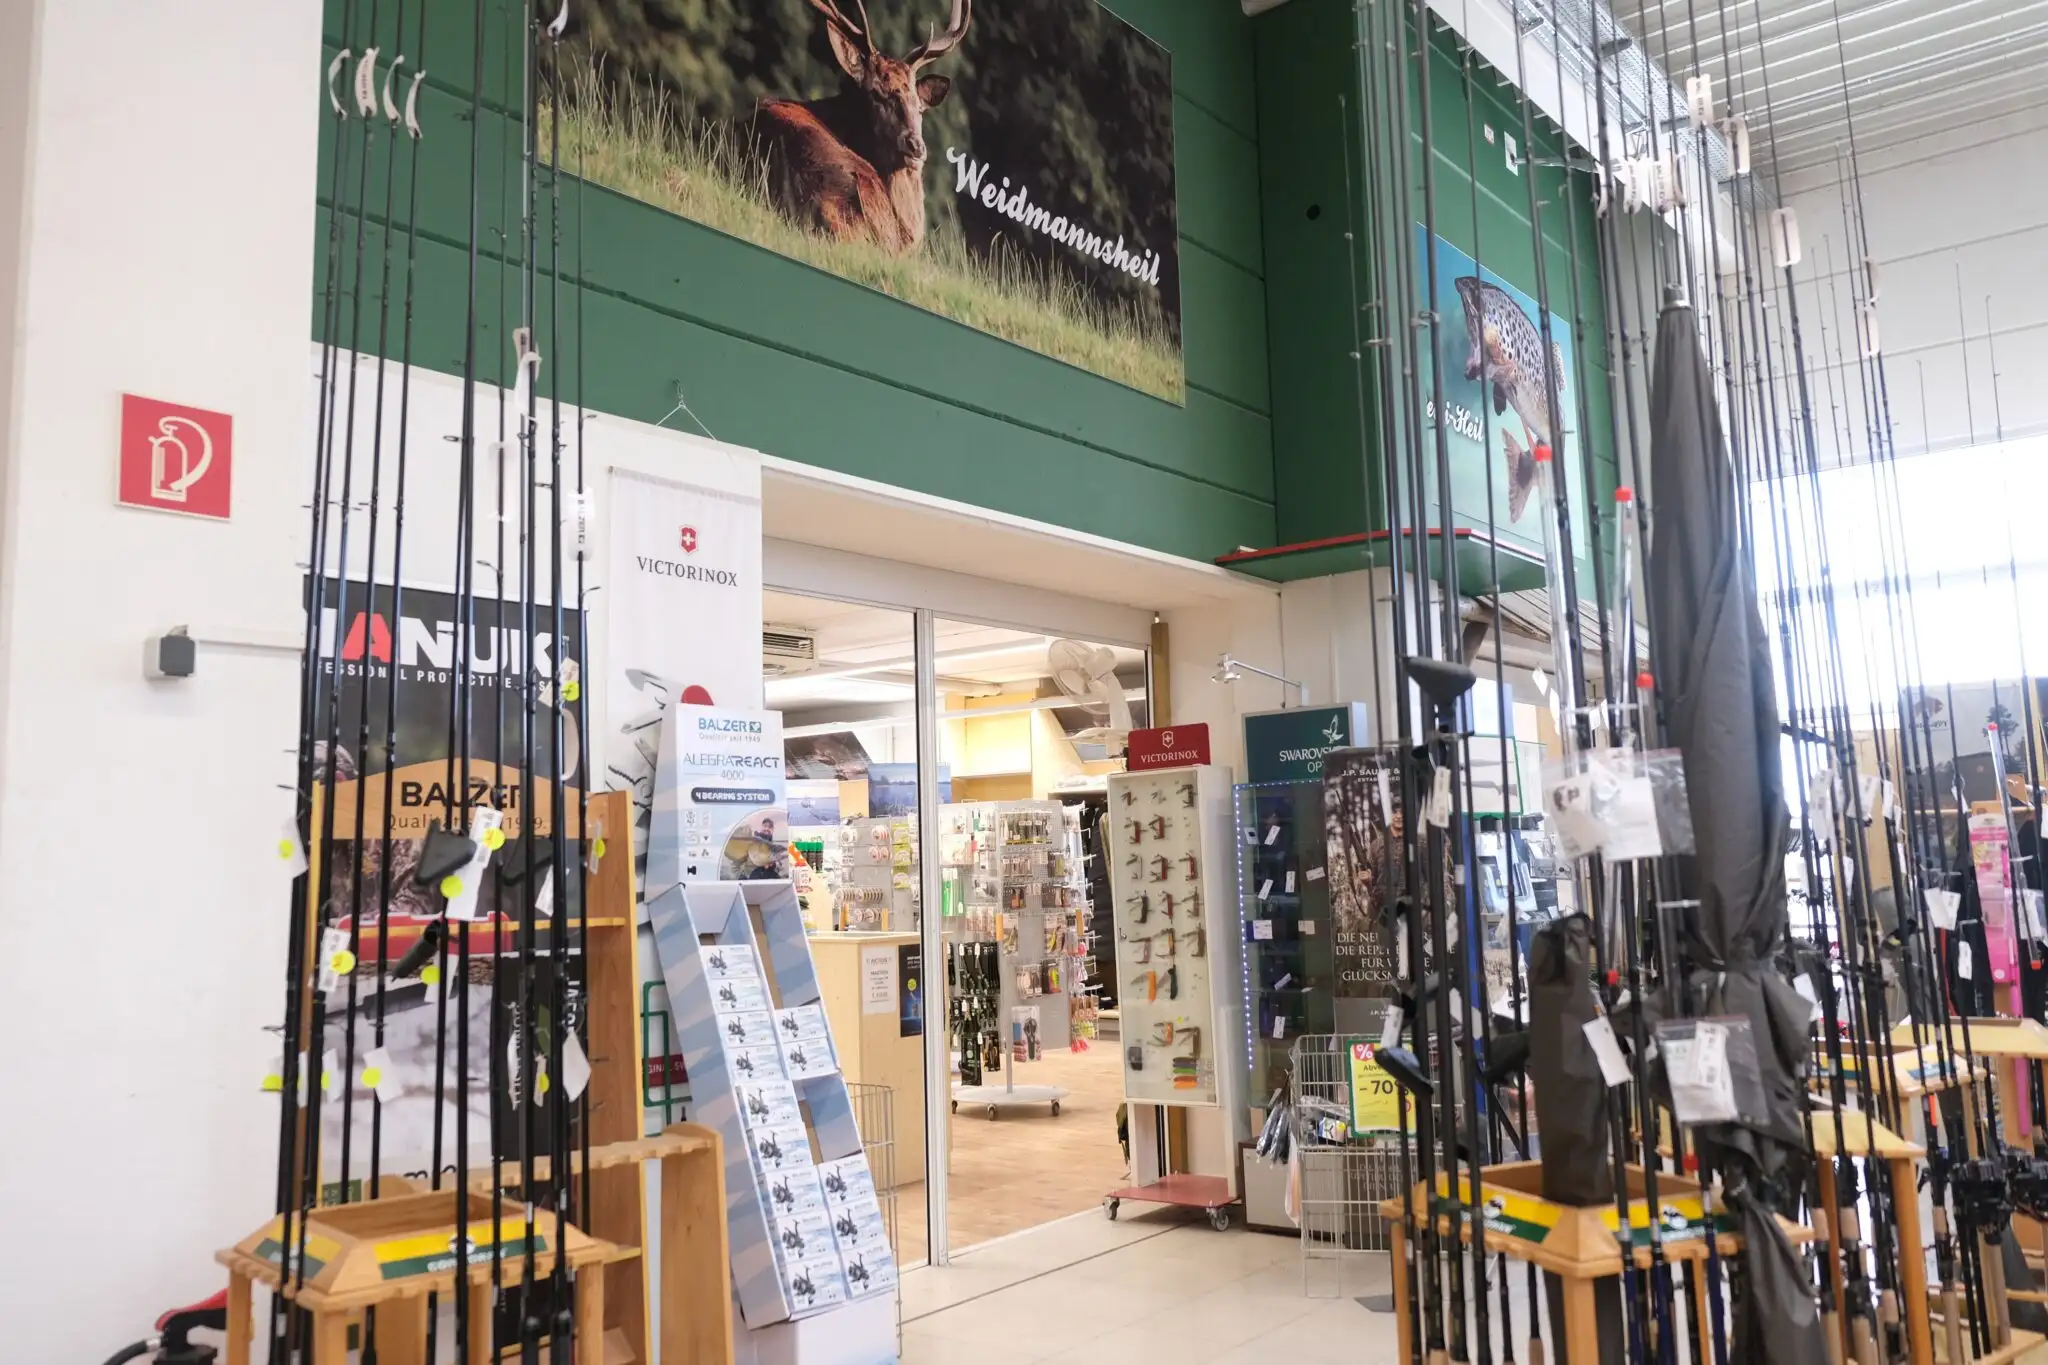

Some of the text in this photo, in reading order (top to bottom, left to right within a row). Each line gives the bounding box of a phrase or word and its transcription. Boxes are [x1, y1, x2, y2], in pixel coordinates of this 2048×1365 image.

[946, 146, 1160, 286] Weidmannsheil
[636, 555, 738, 587] VICTORINOX
[698, 717, 747, 733] BALZER
[1140, 750, 1199, 763] VICTORINOX
[721, 770, 745, 781] 4000
[1360, 767, 1391, 777] SAUR
[702, 792, 736, 800] BEARING
[737, 793, 770, 801] SYSTEM
[1337, 932, 1356, 943] DIE
[1336, 945, 1355, 956] DIE
